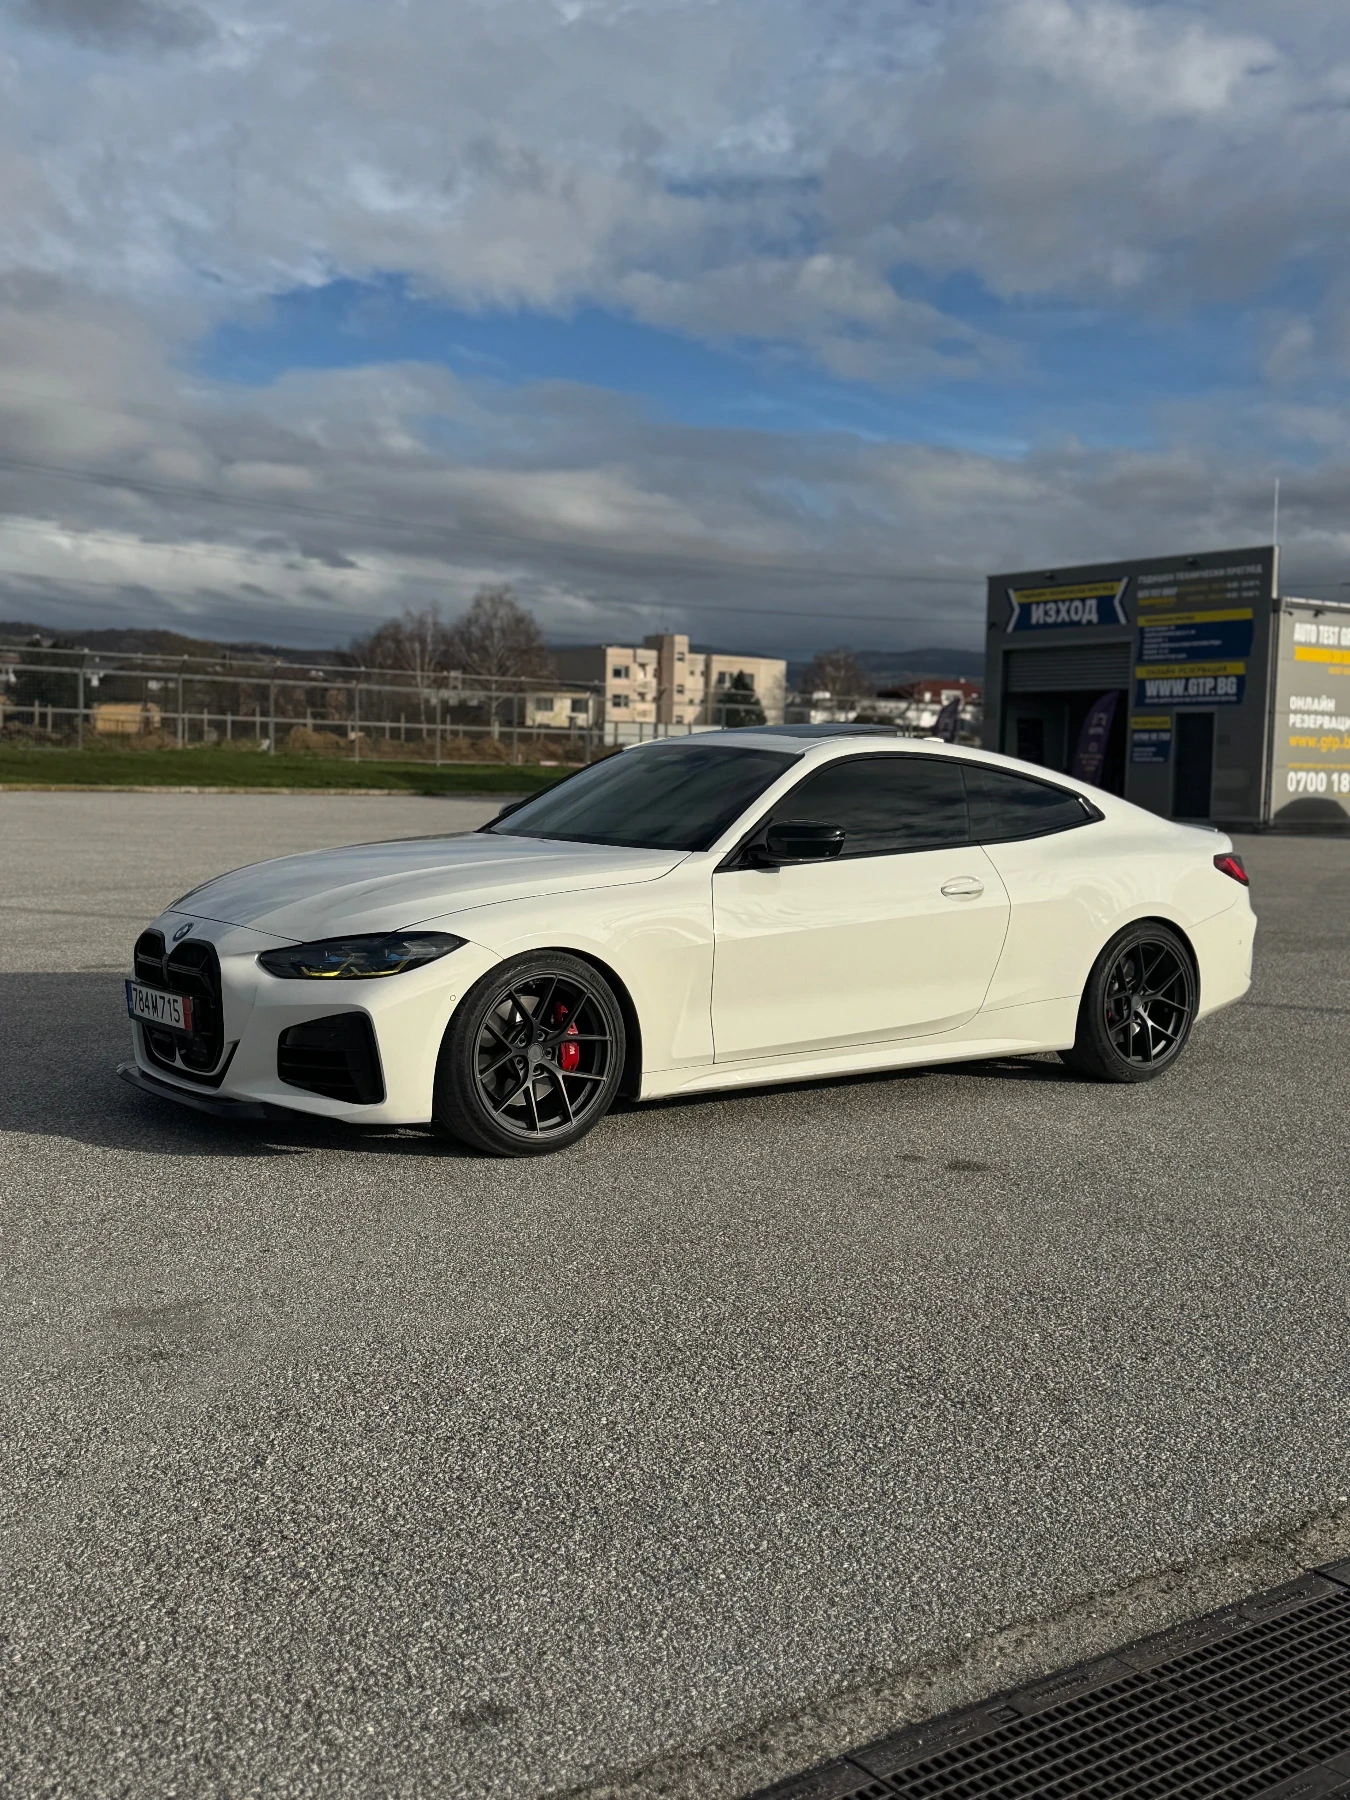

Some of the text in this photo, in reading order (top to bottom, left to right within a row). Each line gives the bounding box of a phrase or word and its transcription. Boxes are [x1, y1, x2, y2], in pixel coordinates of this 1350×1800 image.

[1031, 598, 1098, 625] ИЗХОД
[1318, 624, 1340, 646] TEST
[1145, 676, 1237, 697] WWW.GTP.BG
[1289, 694, 1336, 712] ОНЛАЙН
[1287, 771, 1327, 792] 0700
